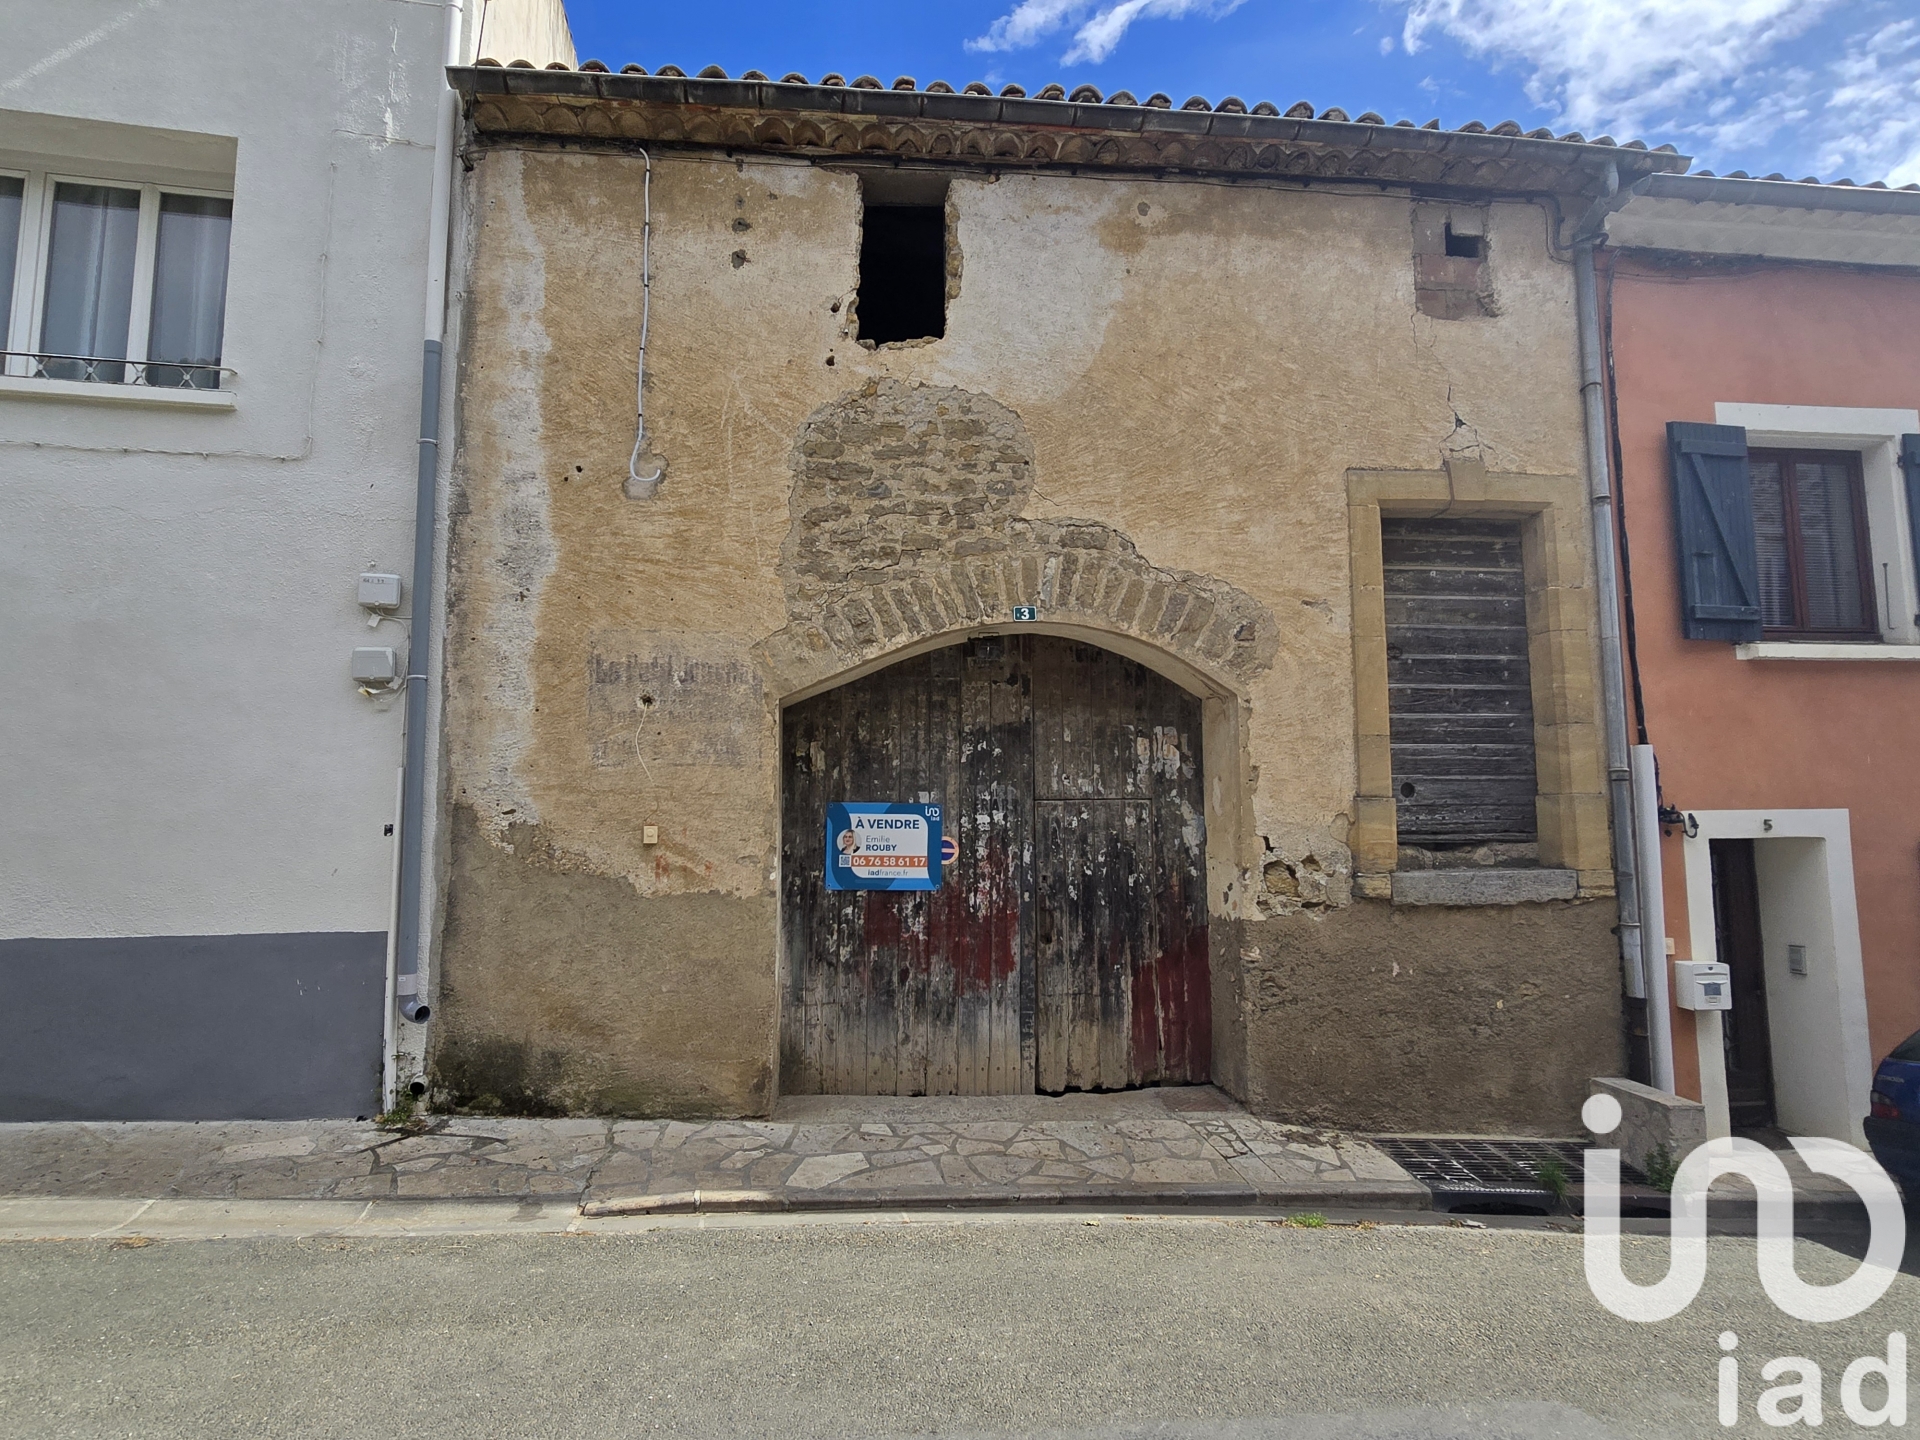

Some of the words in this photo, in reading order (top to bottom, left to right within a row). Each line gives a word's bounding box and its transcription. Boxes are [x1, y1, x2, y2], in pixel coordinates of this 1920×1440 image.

[1020, 607, 1030, 620] 3
[855, 816, 865, 829] À
[867, 819, 919, 829] VENDRE
[1763, 818, 1773, 831] 5
[865, 835, 890, 843] Emilie
[865, 844, 897, 852] ROUBY
[853, 857, 866, 866] 06
[868, 857, 881, 866] 76
[883, 857, 896, 866] 58
[898, 857, 910, 866] 61
[913, 857, 926, 866] 17
